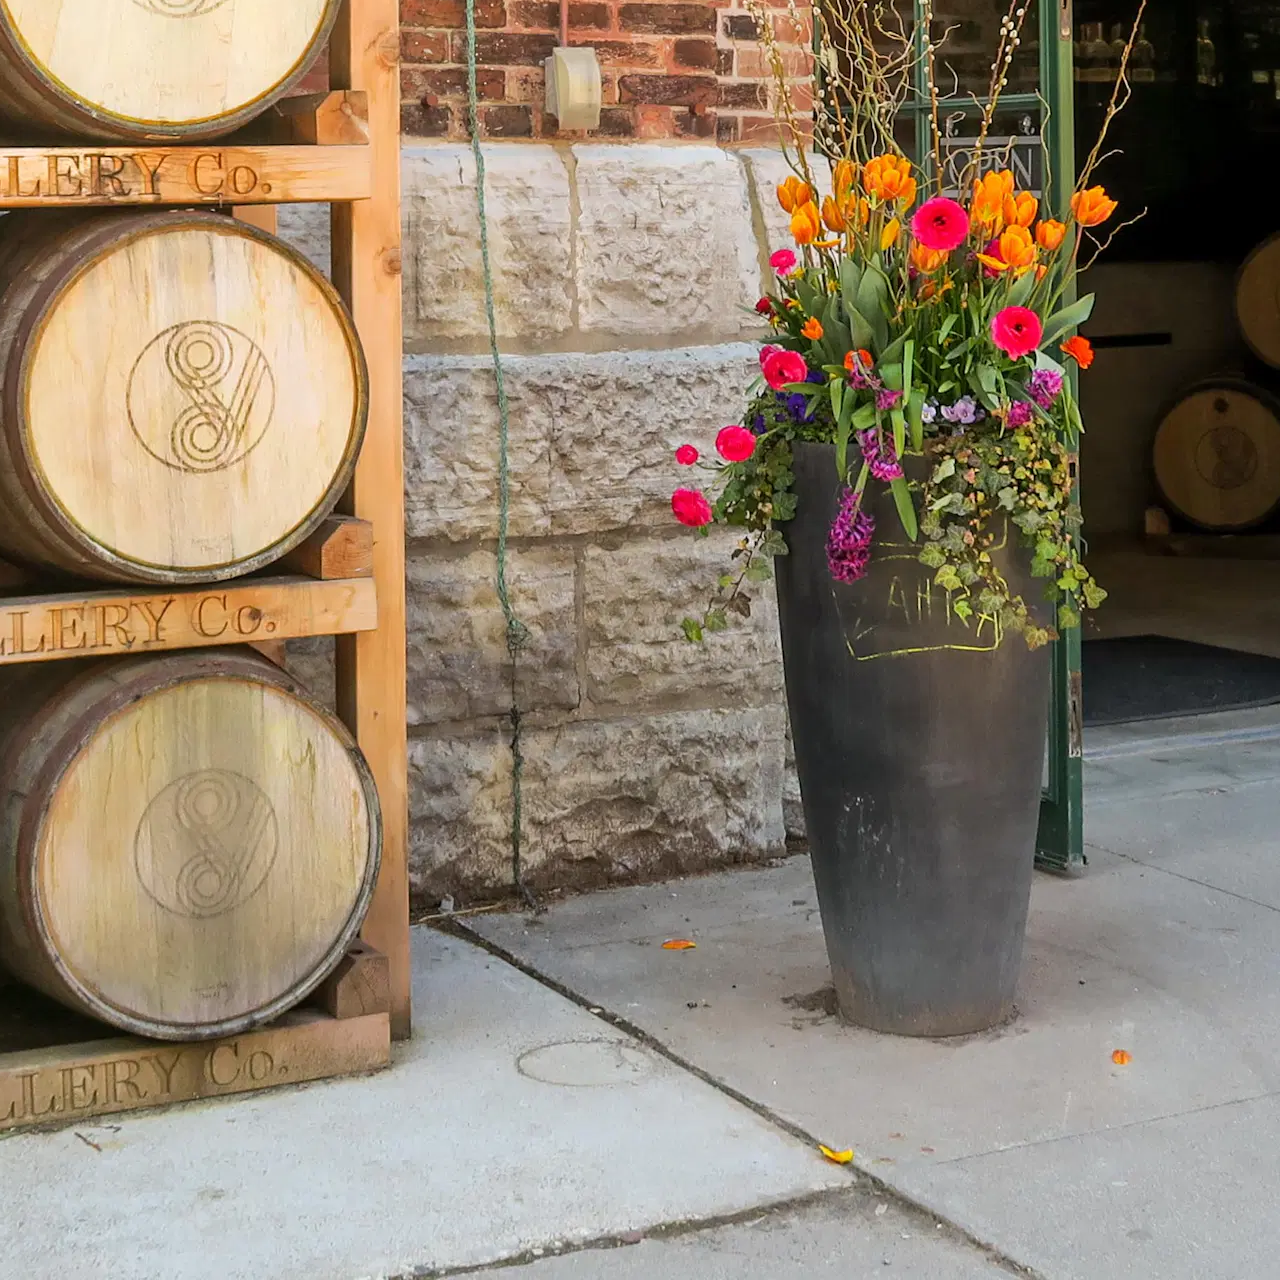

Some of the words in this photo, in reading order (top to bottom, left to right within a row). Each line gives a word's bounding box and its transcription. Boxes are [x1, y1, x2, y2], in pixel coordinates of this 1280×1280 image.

[185, 151, 273, 195] Co.
[190, 593, 278, 638] Co.
[203, 1039, 289, 1085] Co.
